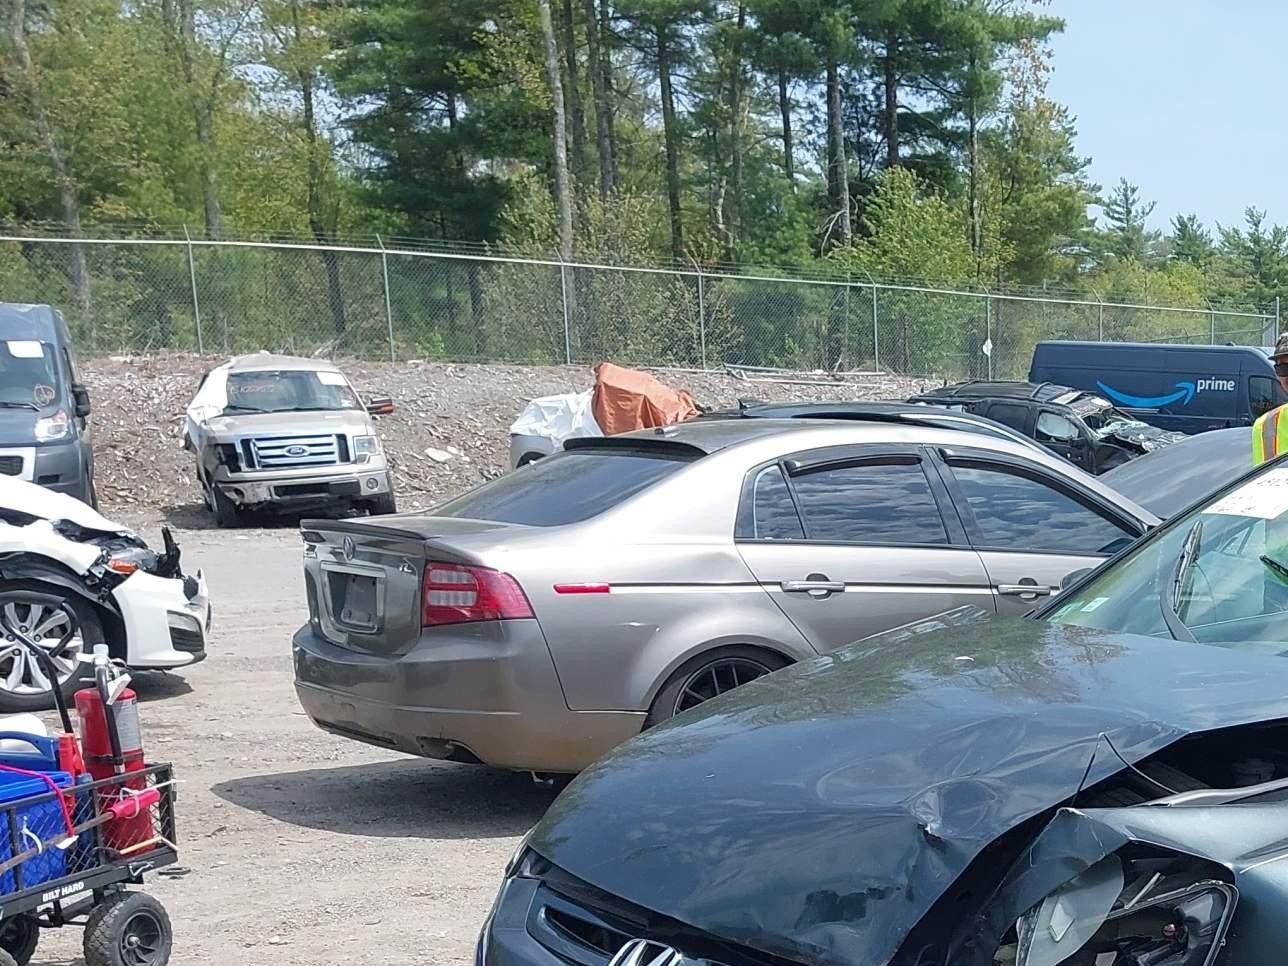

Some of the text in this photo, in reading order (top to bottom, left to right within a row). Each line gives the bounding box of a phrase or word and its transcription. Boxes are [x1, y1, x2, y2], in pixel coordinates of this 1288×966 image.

[1197, 376, 1236, 393] prime
[42, 881, 85, 903] BILT HARD
